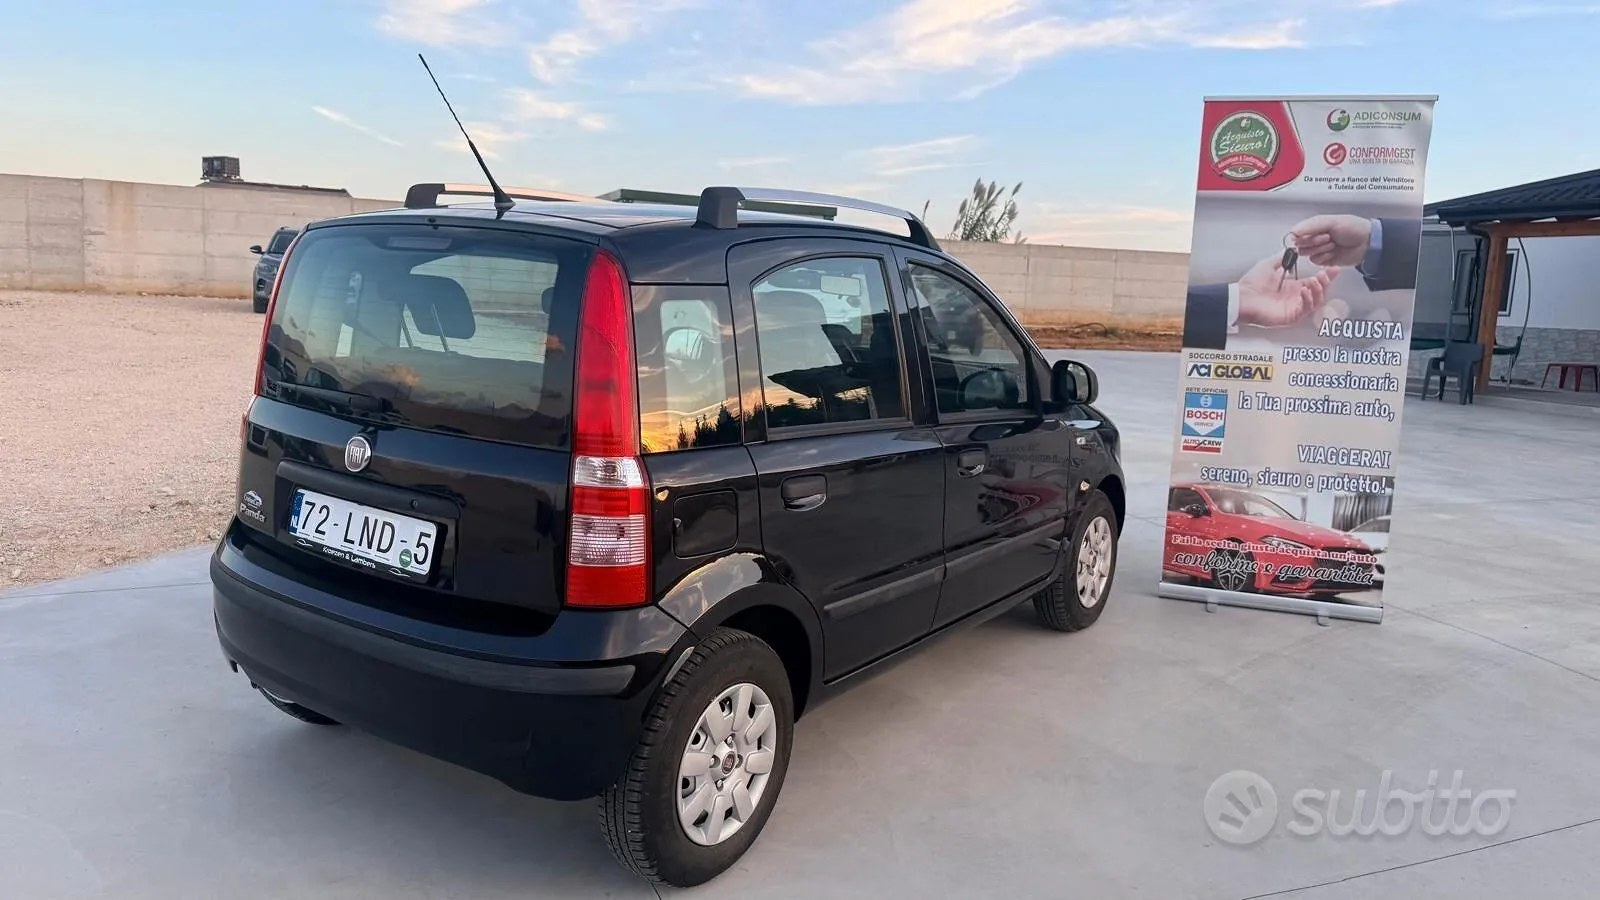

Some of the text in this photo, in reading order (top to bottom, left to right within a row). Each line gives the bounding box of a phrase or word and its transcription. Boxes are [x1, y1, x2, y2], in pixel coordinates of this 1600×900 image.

[1353, 111, 1422, 121] ADICONSUM
[1218, 134, 1270, 155] Sicuro!
[1221, 129, 1264, 142] Acquisto
[1349, 147, 1416, 159] CONFORMGEST
[1314, 176, 1340, 184] sempre
[1319, 319, 1403, 340] ACQUISTA
[1189, 353, 1273, 362] SOCCORSO STRADALE
[1283, 345, 1401, 366] presso la nostra
[1187, 363, 1272, 380] ACI GLOBAL
[1289, 371, 1399, 392] concessionaria
[1187, 411, 1223, 420] BOSCH
[1238, 391, 1395, 422] la Tua prossima auto,
[350, 446, 365, 464] FIAT
[1298, 445, 1391, 469] VIAGGERAI
[1201, 466, 1387, 494] sereno, sicuro e protetto!
[240, 502, 266, 523] Panda
[1172, 535, 1191, 545] Fai
[1192, 536, 1203, 546] la
[1204, 538, 1239, 549] scelta
[1240, 542, 1276, 554] giusta
[1278, 546, 1328, 558] acquista
[350, 554, 376, 569] Lambers
[1172, 550, 1377, 585] conforme e garantita
